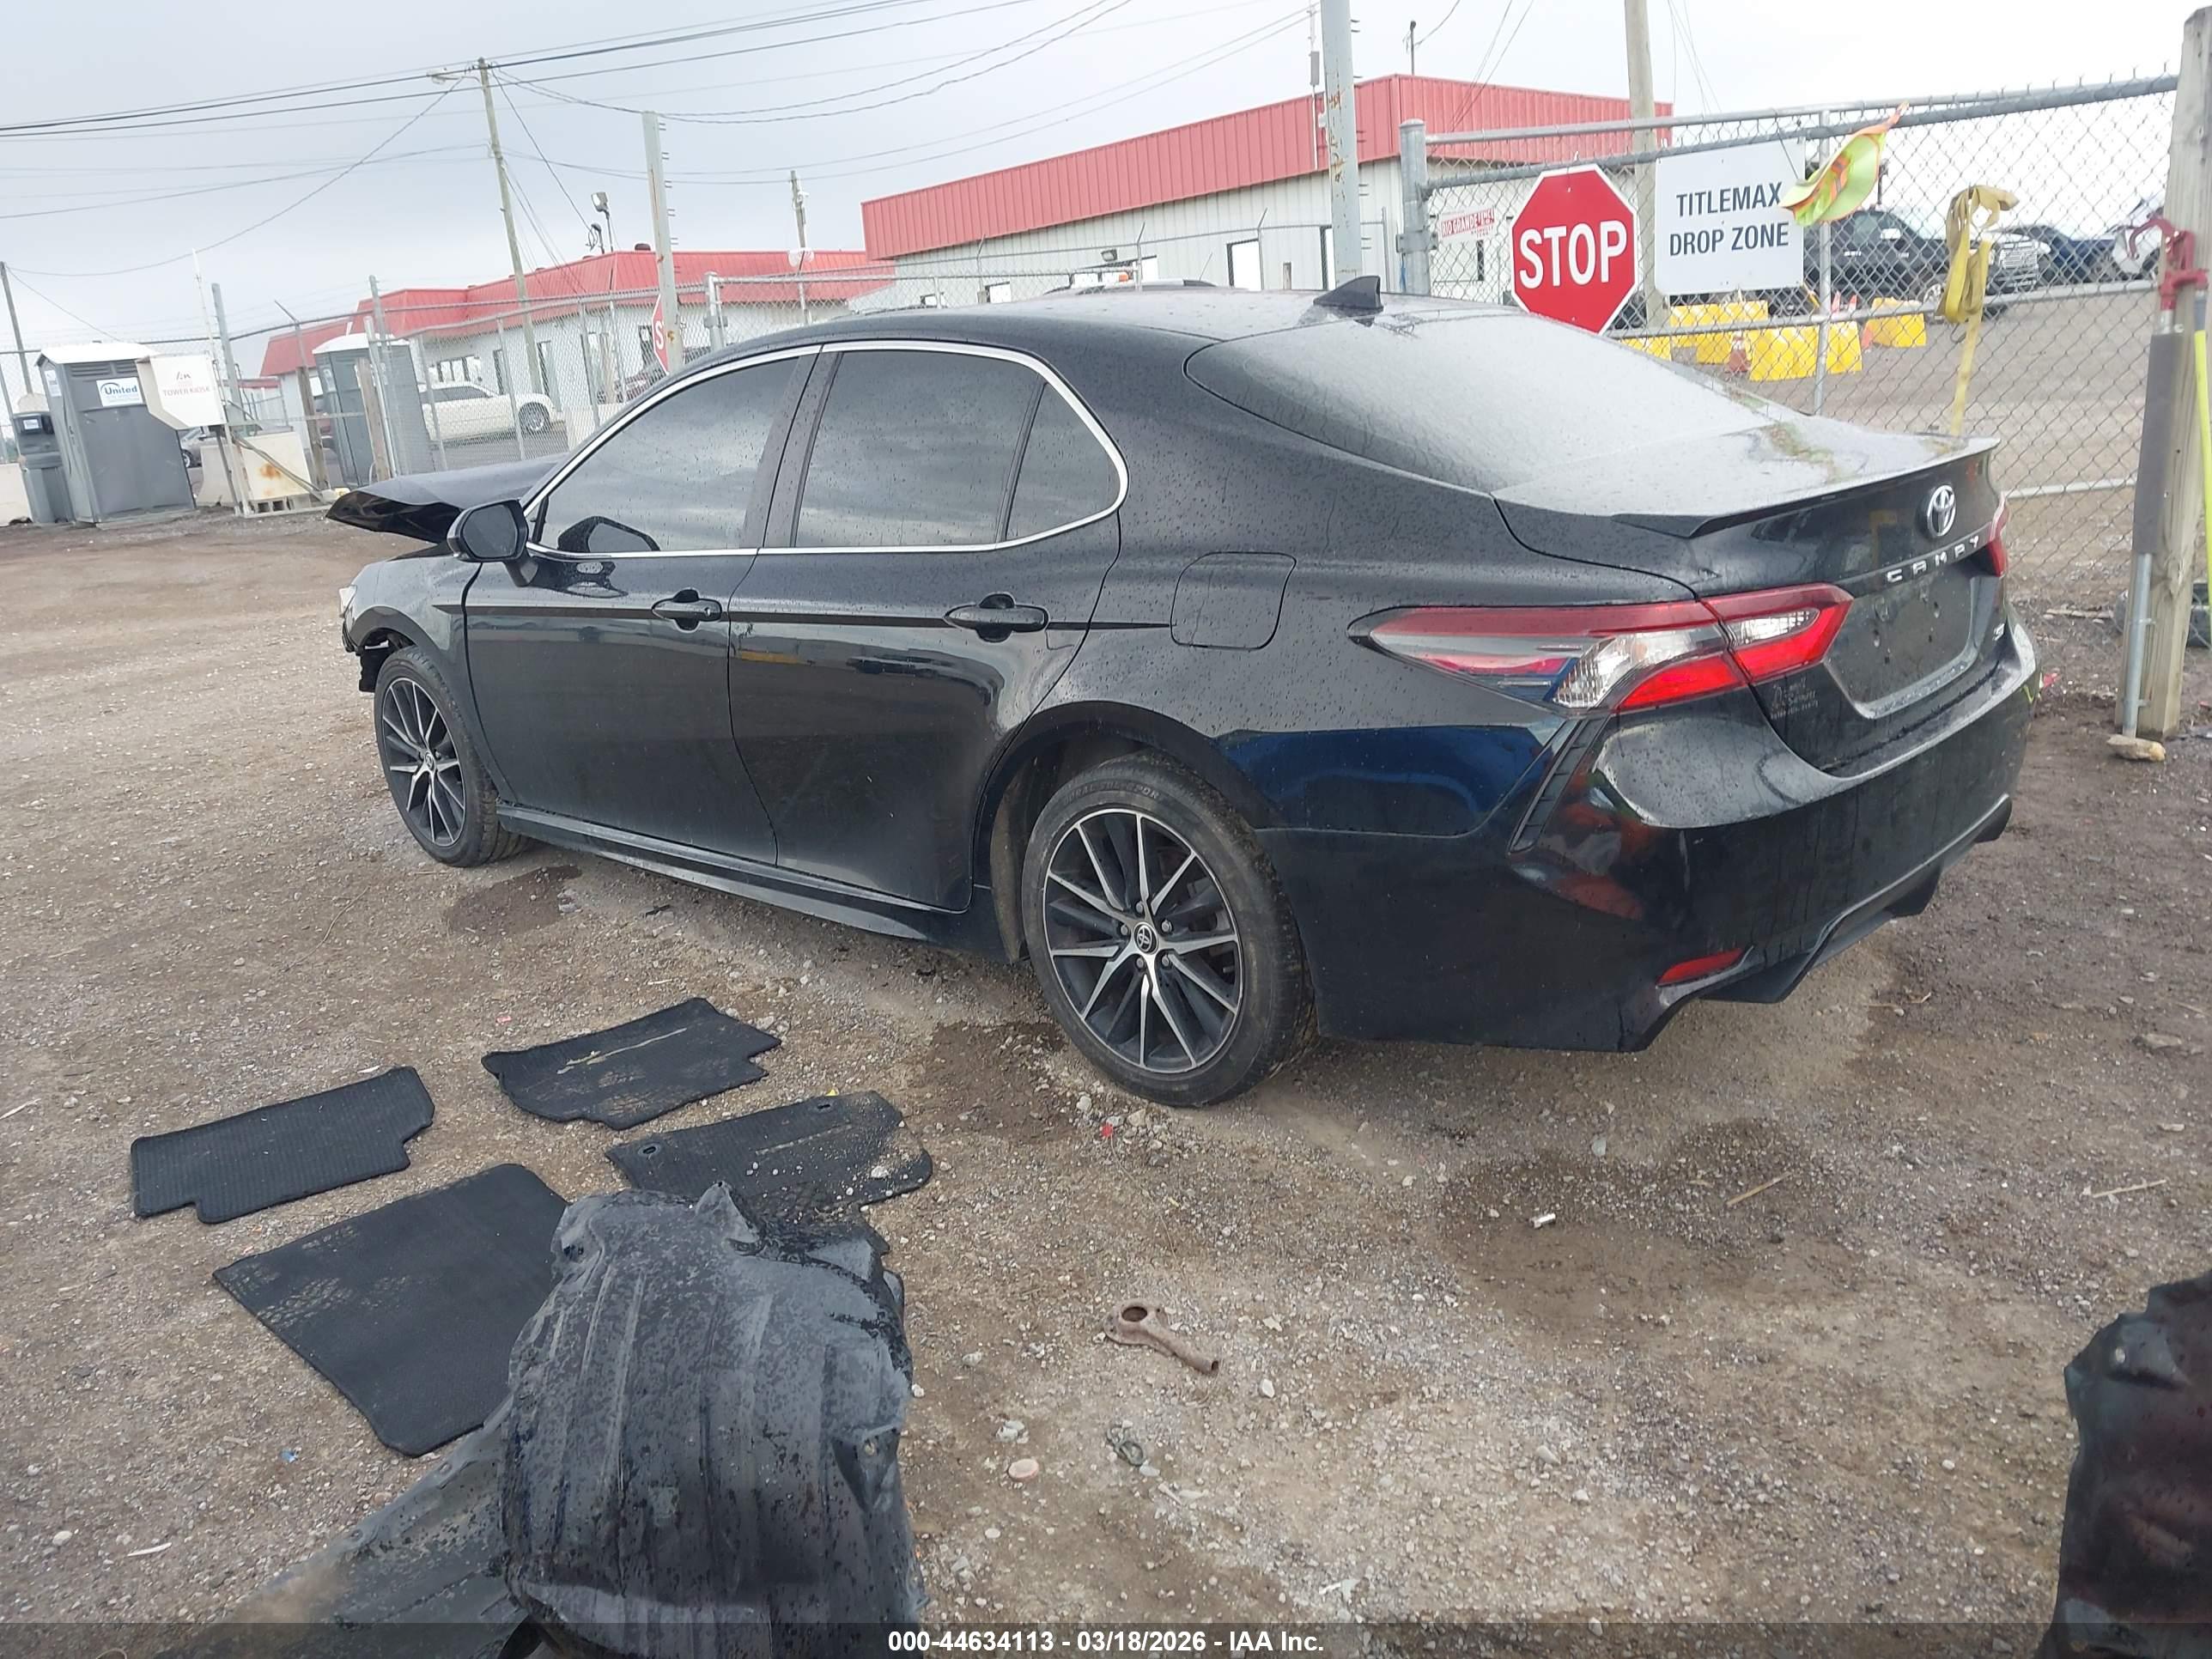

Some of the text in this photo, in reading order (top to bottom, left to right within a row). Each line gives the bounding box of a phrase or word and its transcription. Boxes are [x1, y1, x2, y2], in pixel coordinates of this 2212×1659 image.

[1676, 181, 1783, 216] TITLEMAX
[1519, 220, 1627, 289] STOP
[1669, 222, 1789, 256] DROP ZONE
[105, 385, 137, 395] United
[162, 387, 190, 397] TOWER
[1887, 534, 1979, 583] CAMRY
